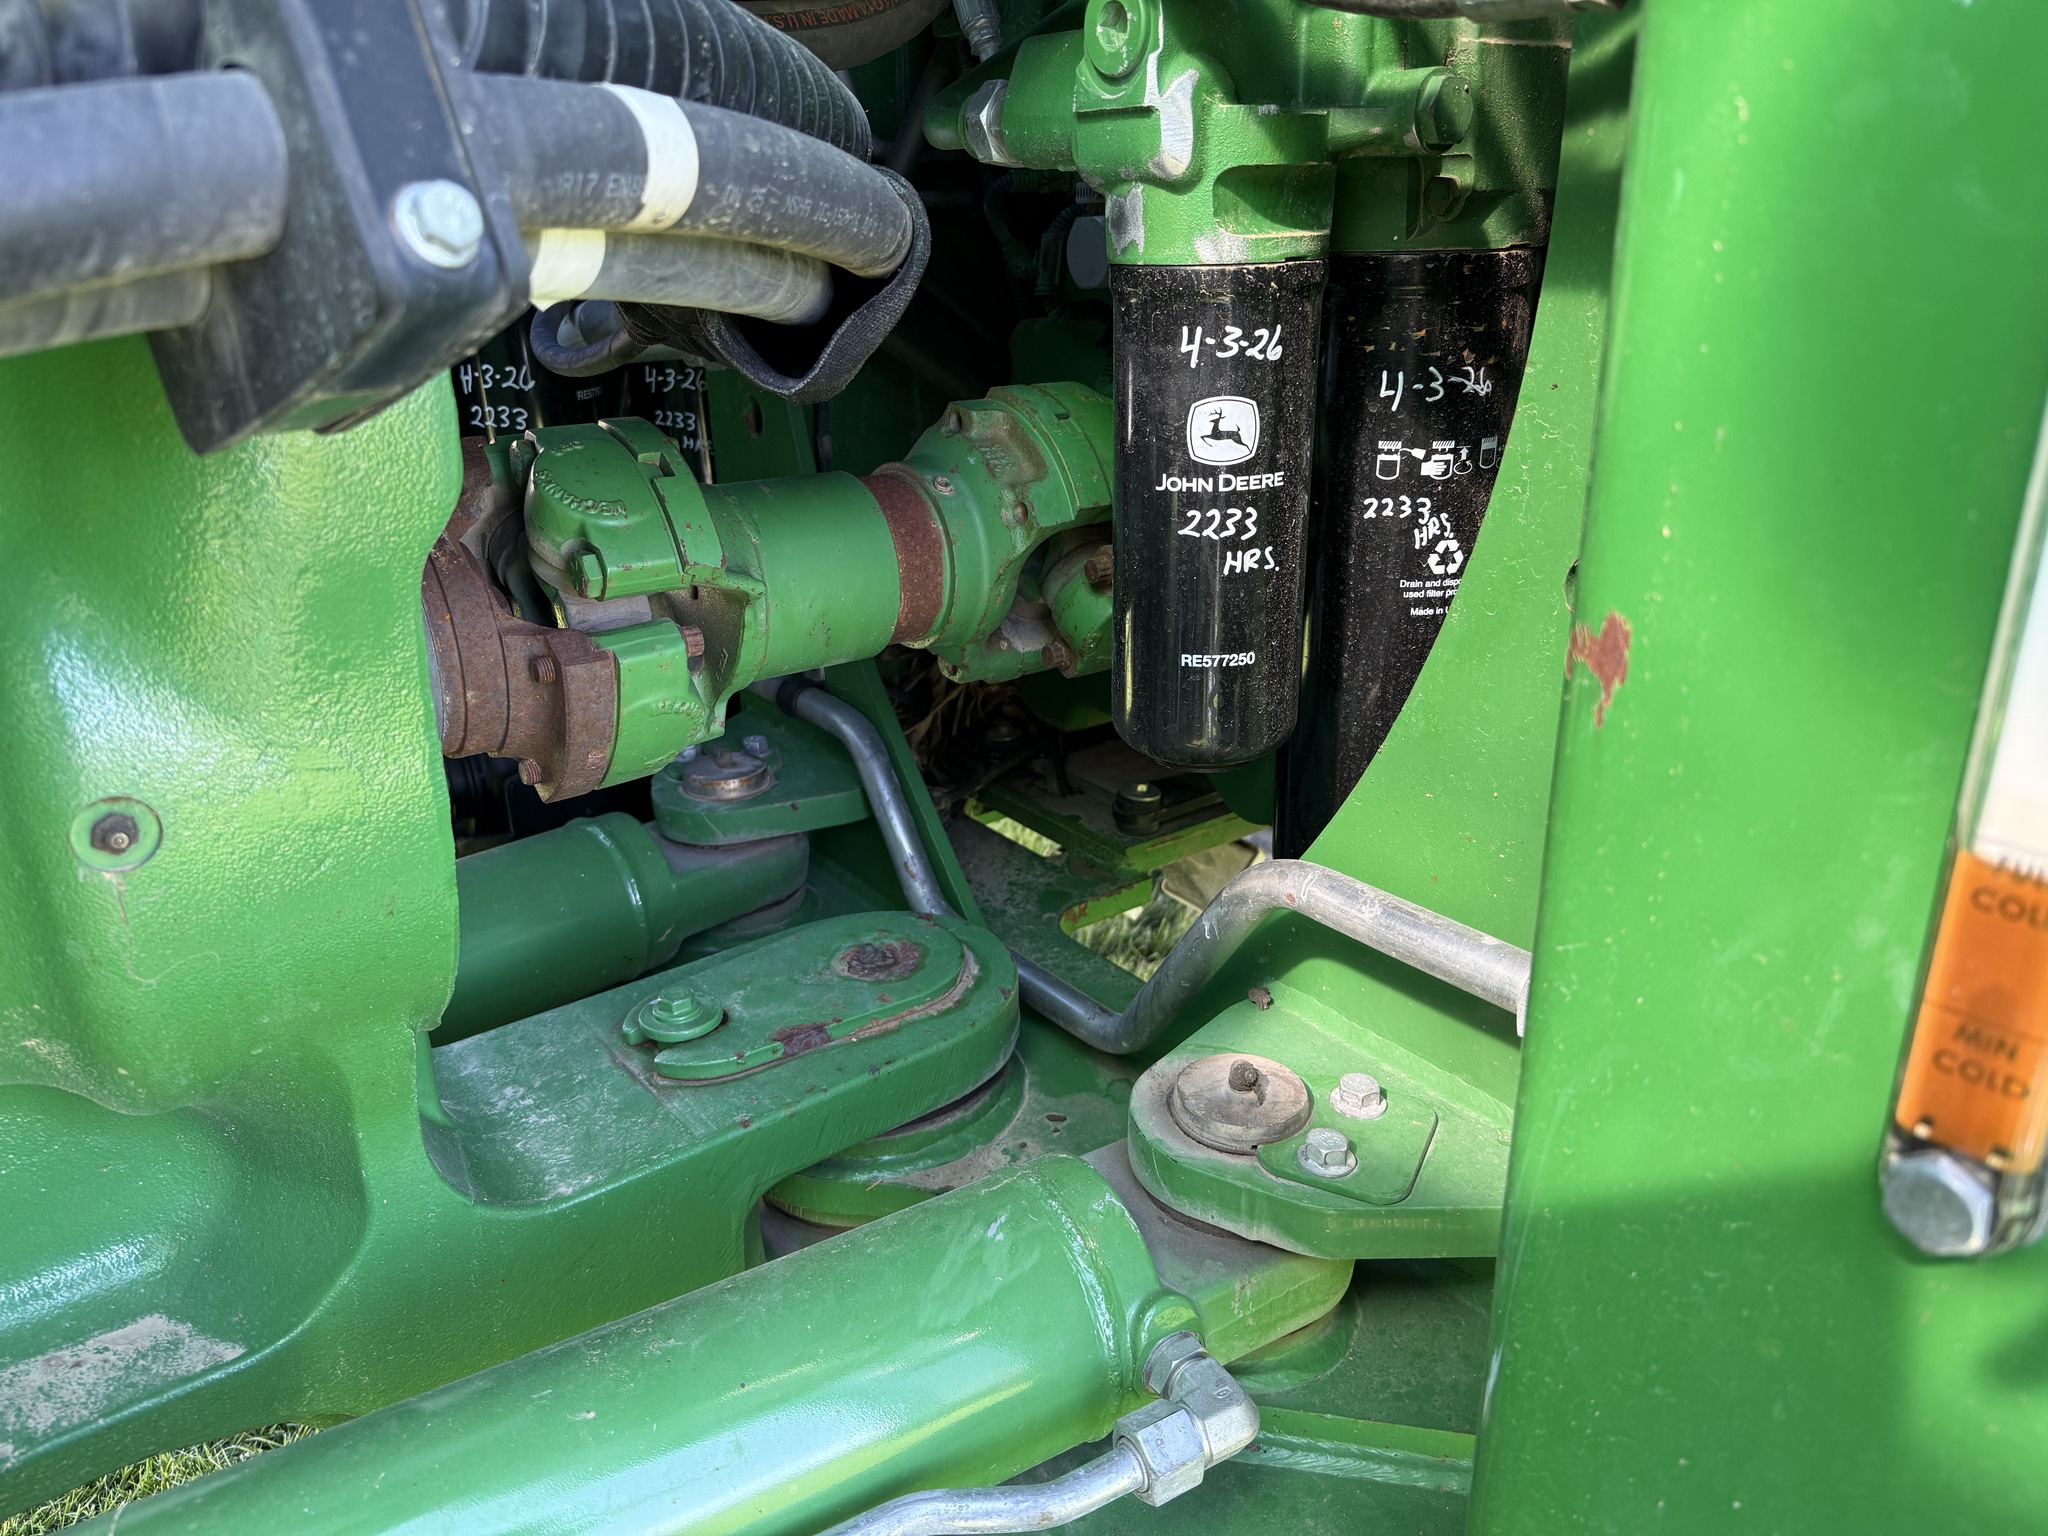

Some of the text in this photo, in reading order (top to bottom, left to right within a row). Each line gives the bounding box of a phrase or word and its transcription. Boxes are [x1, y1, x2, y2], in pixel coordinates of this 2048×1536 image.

[802, 11, 818, 28] IN
[820, 4, 859, 25] MADE
[1181, 324, 1284, 368] 4-3-26
[645, 365, 708, 393] 4-3-26
[1380, 366, 1492, 411] 4-3-26
[470, 405, 528, 431] 2233
[655, 410, 696, 431] 2233
[1156, 472, 1284, 492] JOHN DEERE
[1178, 507, 1258, 540] 2233
[1363, 495, 1431, 524] 2233
[1413, 513, 1454, 549] HRS.
[1223, 546, 1280, 575] HRS.
[1400, 579, 1423, 588] Drain
[1425, 579, 1441, 588] and
[1403, 589, 1425, 598] used
[1426, 589, 1444, 598] filter
[1410, 607, 1434, 616] Made
[1436, 606, 1443, 615] in
[1181, 652, 1256, 668] RE577250
[1969, 886, 2048, 931] COL
[1952, 1022, 2019, 1062] MIN
[1931, 1048, 2031, 1099] COLD
